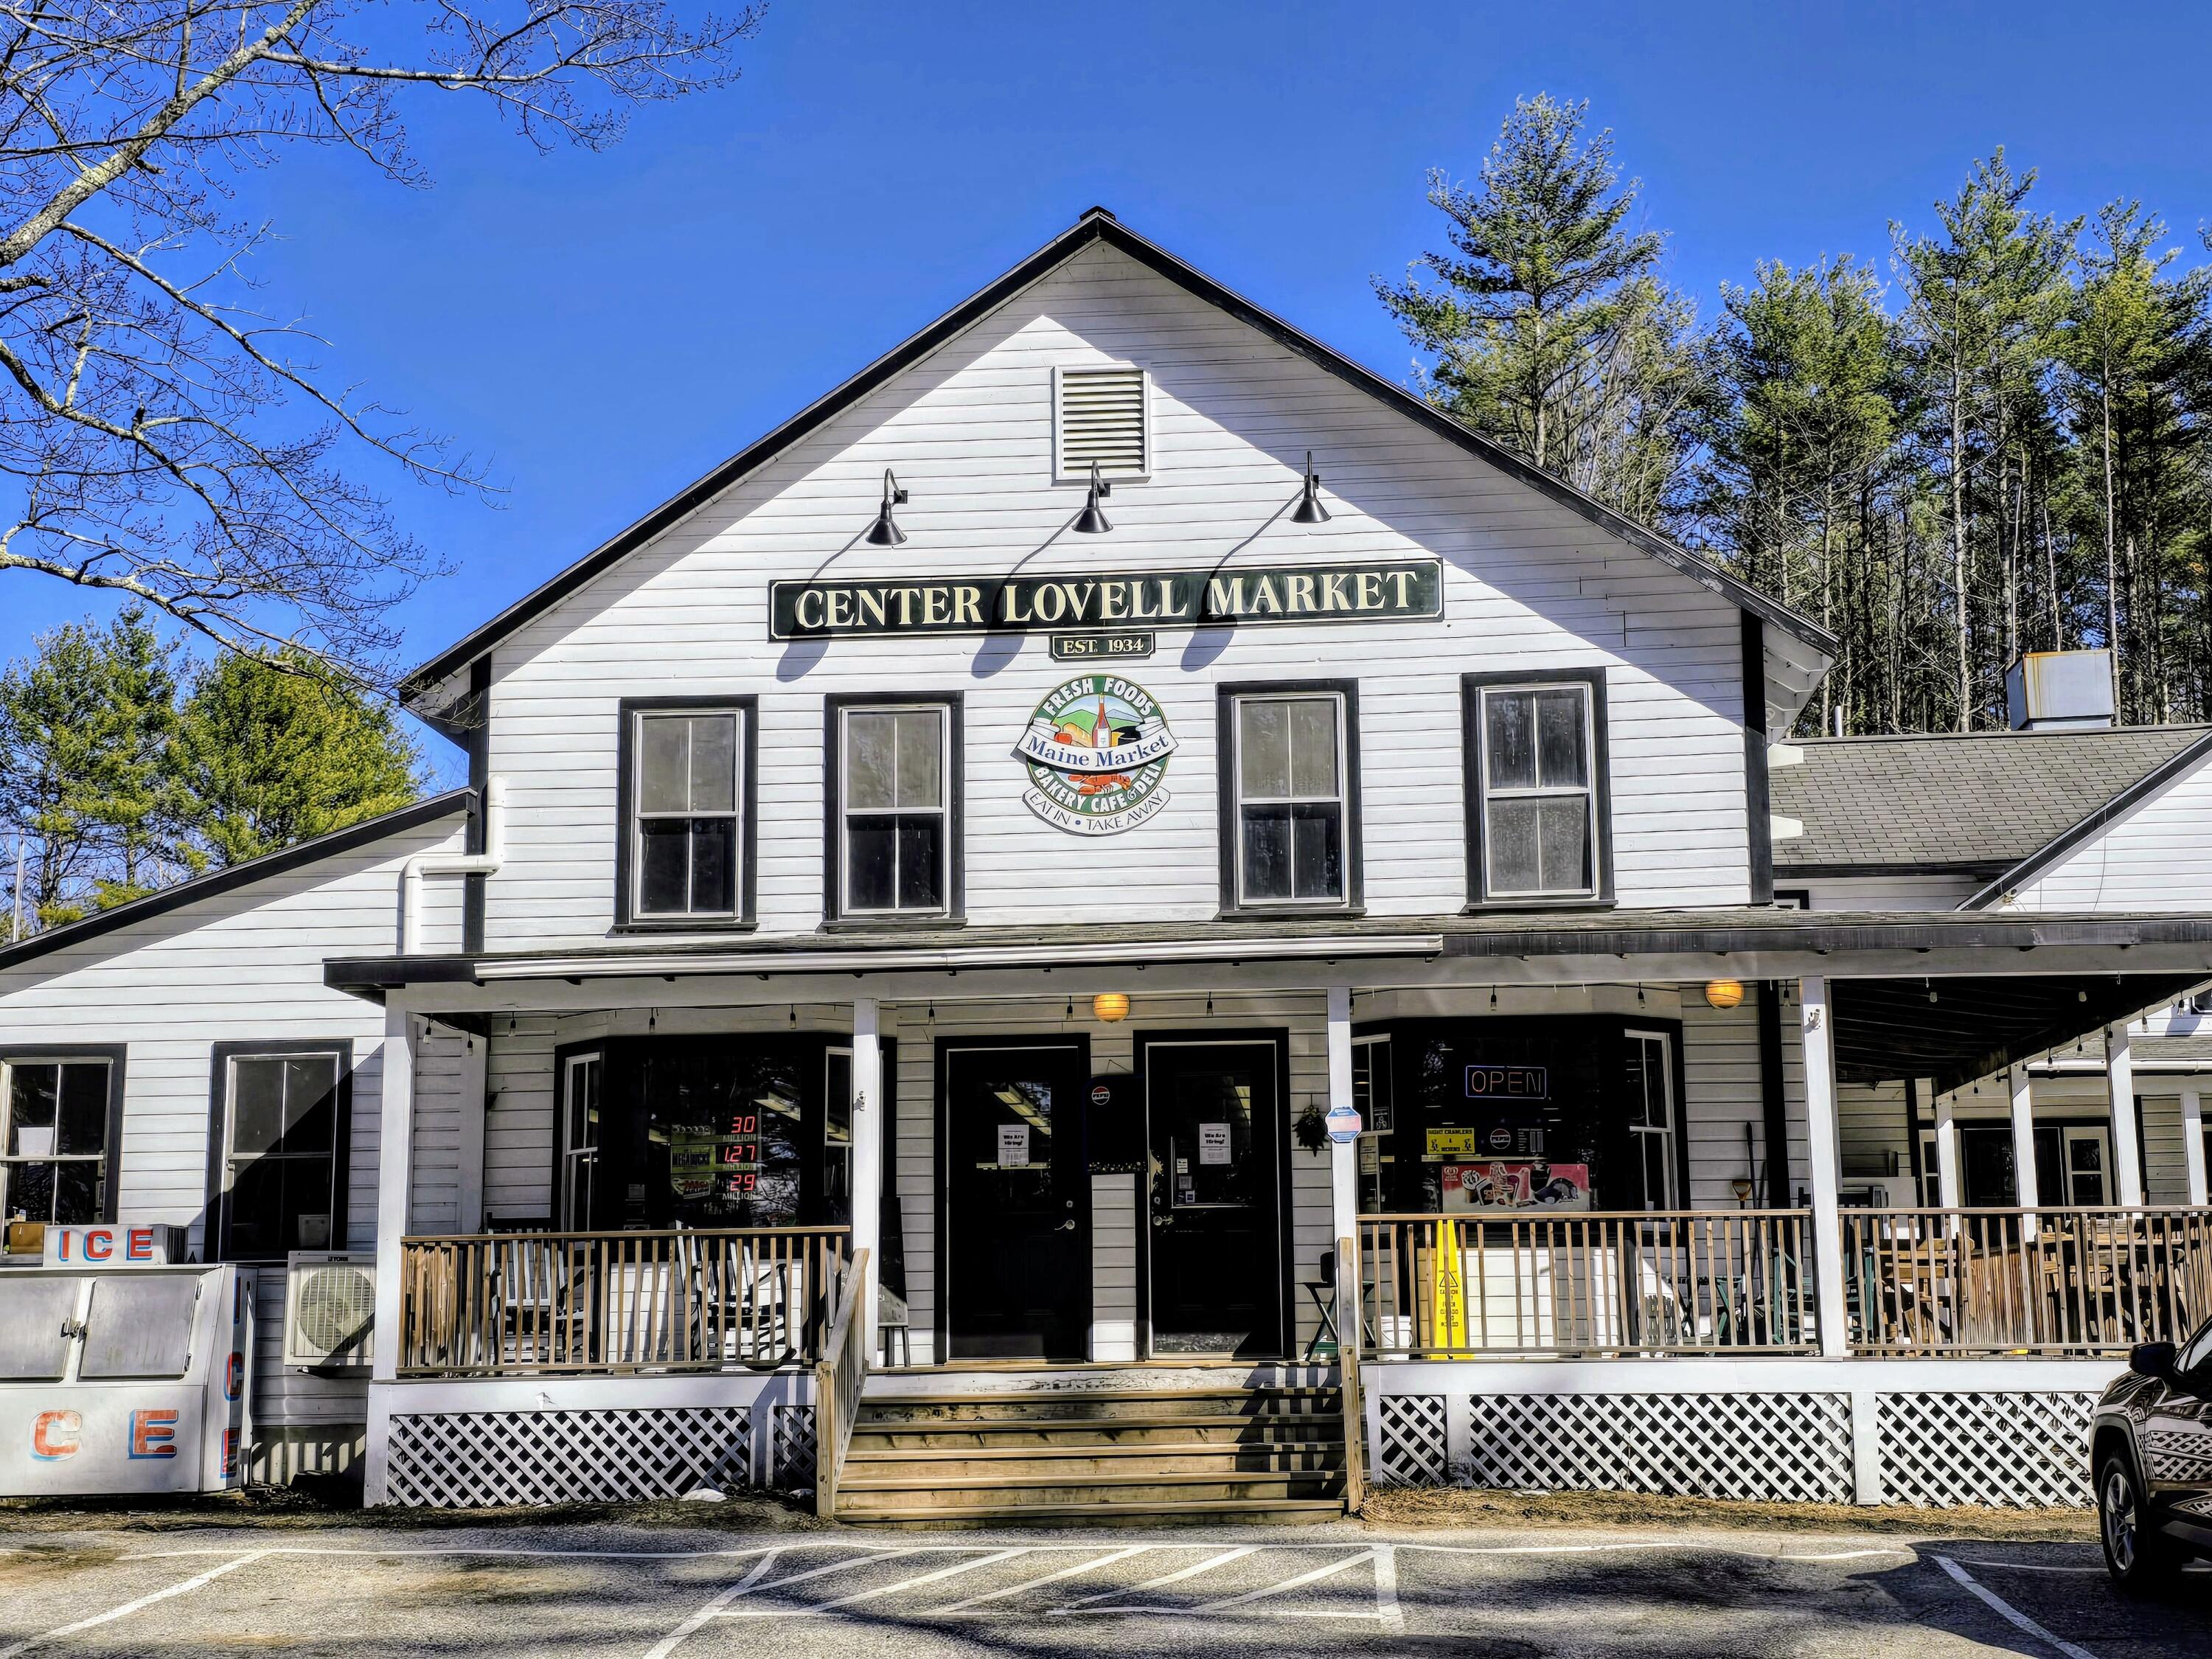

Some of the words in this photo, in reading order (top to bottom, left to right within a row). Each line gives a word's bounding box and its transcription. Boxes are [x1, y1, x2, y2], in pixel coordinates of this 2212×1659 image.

[796, 585, 984, 628] CENTER
[1003, 578, 1188, 624] LOVELL
[1208, 571, 1419, 616] MARKET
[1063, 639, 1098, 654] EST.
[1108, 638, 1144, 653] 1934
[1042, 678, 1094, 716] FRESH
[1104, 678, 1155, 716] FOODS
[1026, 737, 1090, 766] Maine
[1095, 734, 1169, 767] Market
[1034, 767, 1087, 810] BAKERY
[1091, 795, 1127, 812] CAFE
[1127, 788, 1137, 801] &
[1137, 762, 1163, 799] DELI
[1029, 792, 1056, 814] EAT
[1053, 810, 1071, 825] IN
[1086, 816, 1124, 831] TAKE
[1127, 791, 1164, 825] AWAY
[1472, 1071, 1541, 1093] OPEN
[731, 1116, 755, 1133] 30
[725, 1145, 755, 1163] 1.27
[731, 1175, 755, 1191] 29
[59, 1229, 153, 1262] ICE
